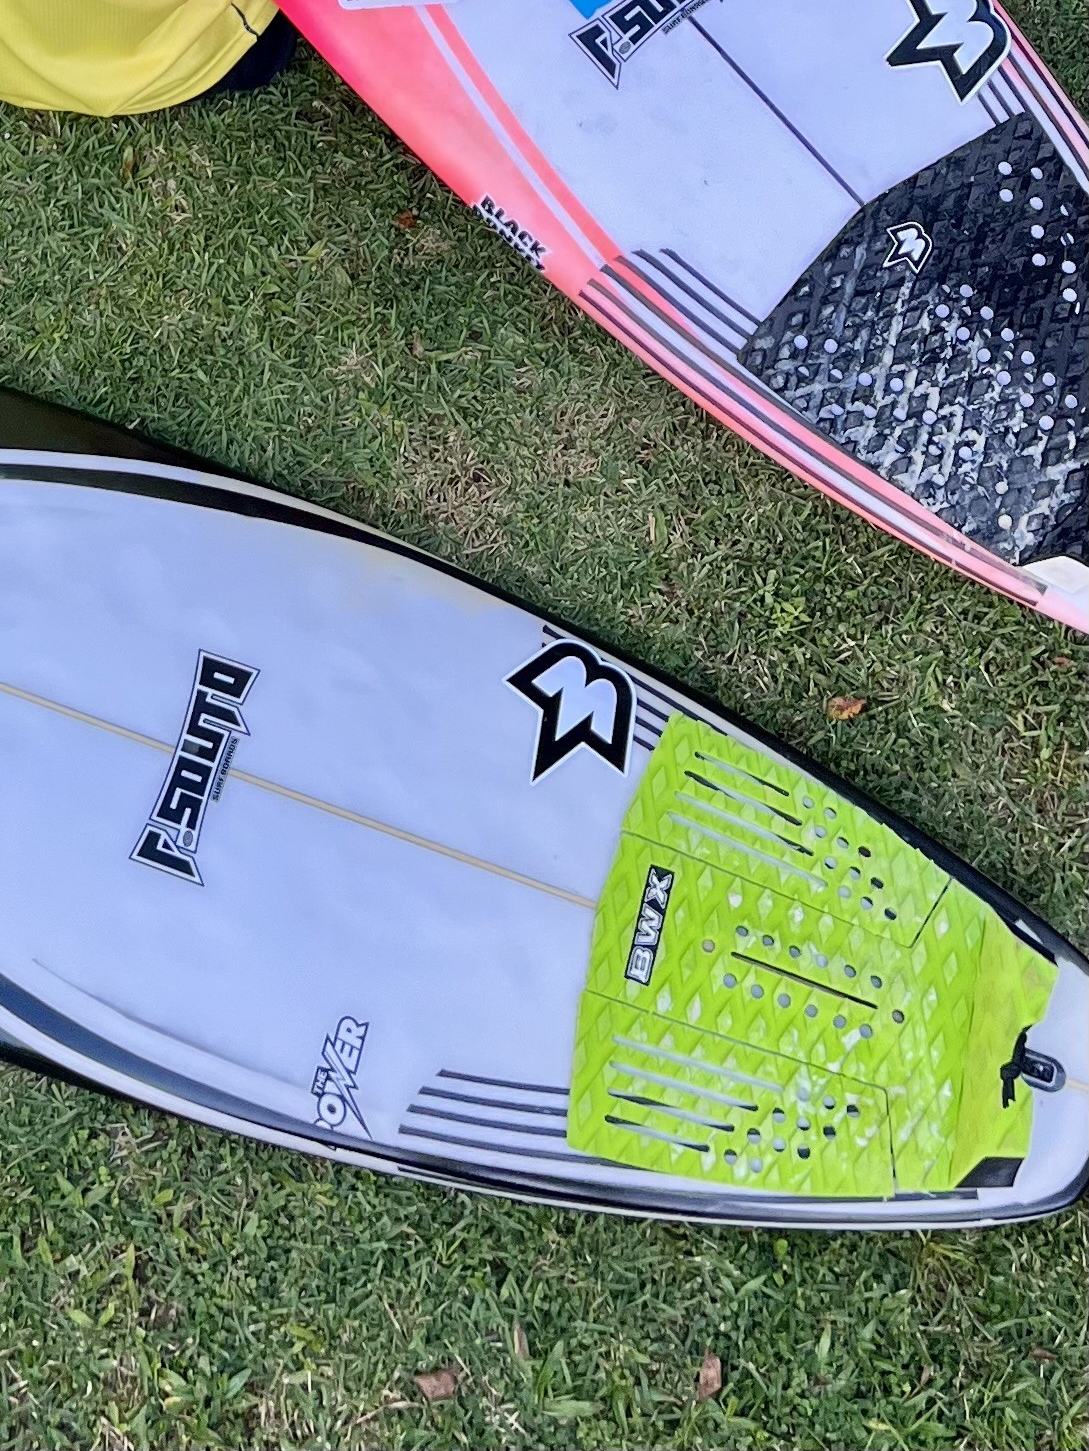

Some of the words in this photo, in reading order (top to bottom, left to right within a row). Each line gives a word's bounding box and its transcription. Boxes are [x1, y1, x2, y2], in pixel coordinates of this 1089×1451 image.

[480, 195, 546, 259] BLACK
[626, 867, 672, 983] BWX
[312, 1067, 328, 1096] THE
